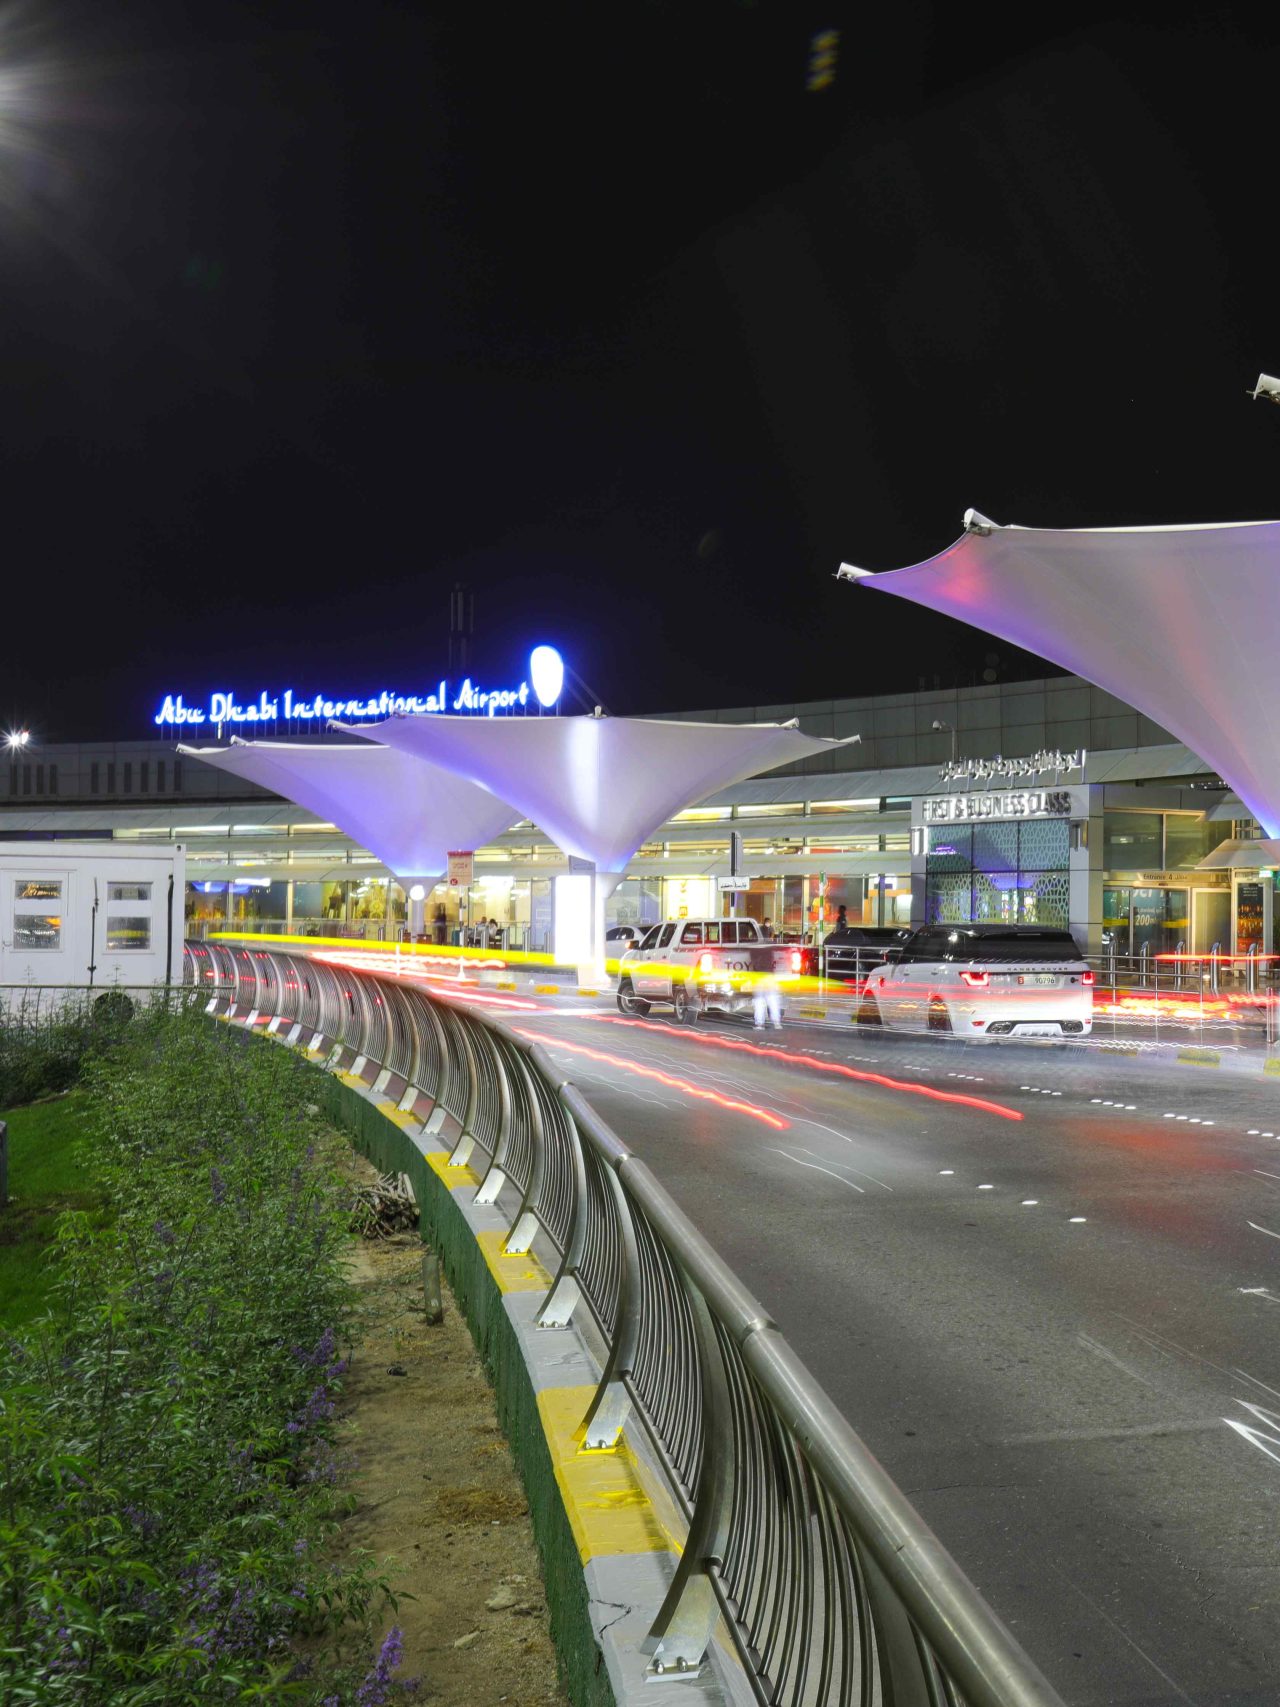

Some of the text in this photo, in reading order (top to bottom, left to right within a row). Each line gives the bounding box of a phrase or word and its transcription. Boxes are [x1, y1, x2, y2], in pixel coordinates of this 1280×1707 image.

[155, 678, 529, 724] Abu Dhabi International Airport
[922, 791, 1072, 820] FIRST & BUSINESS CLASS
